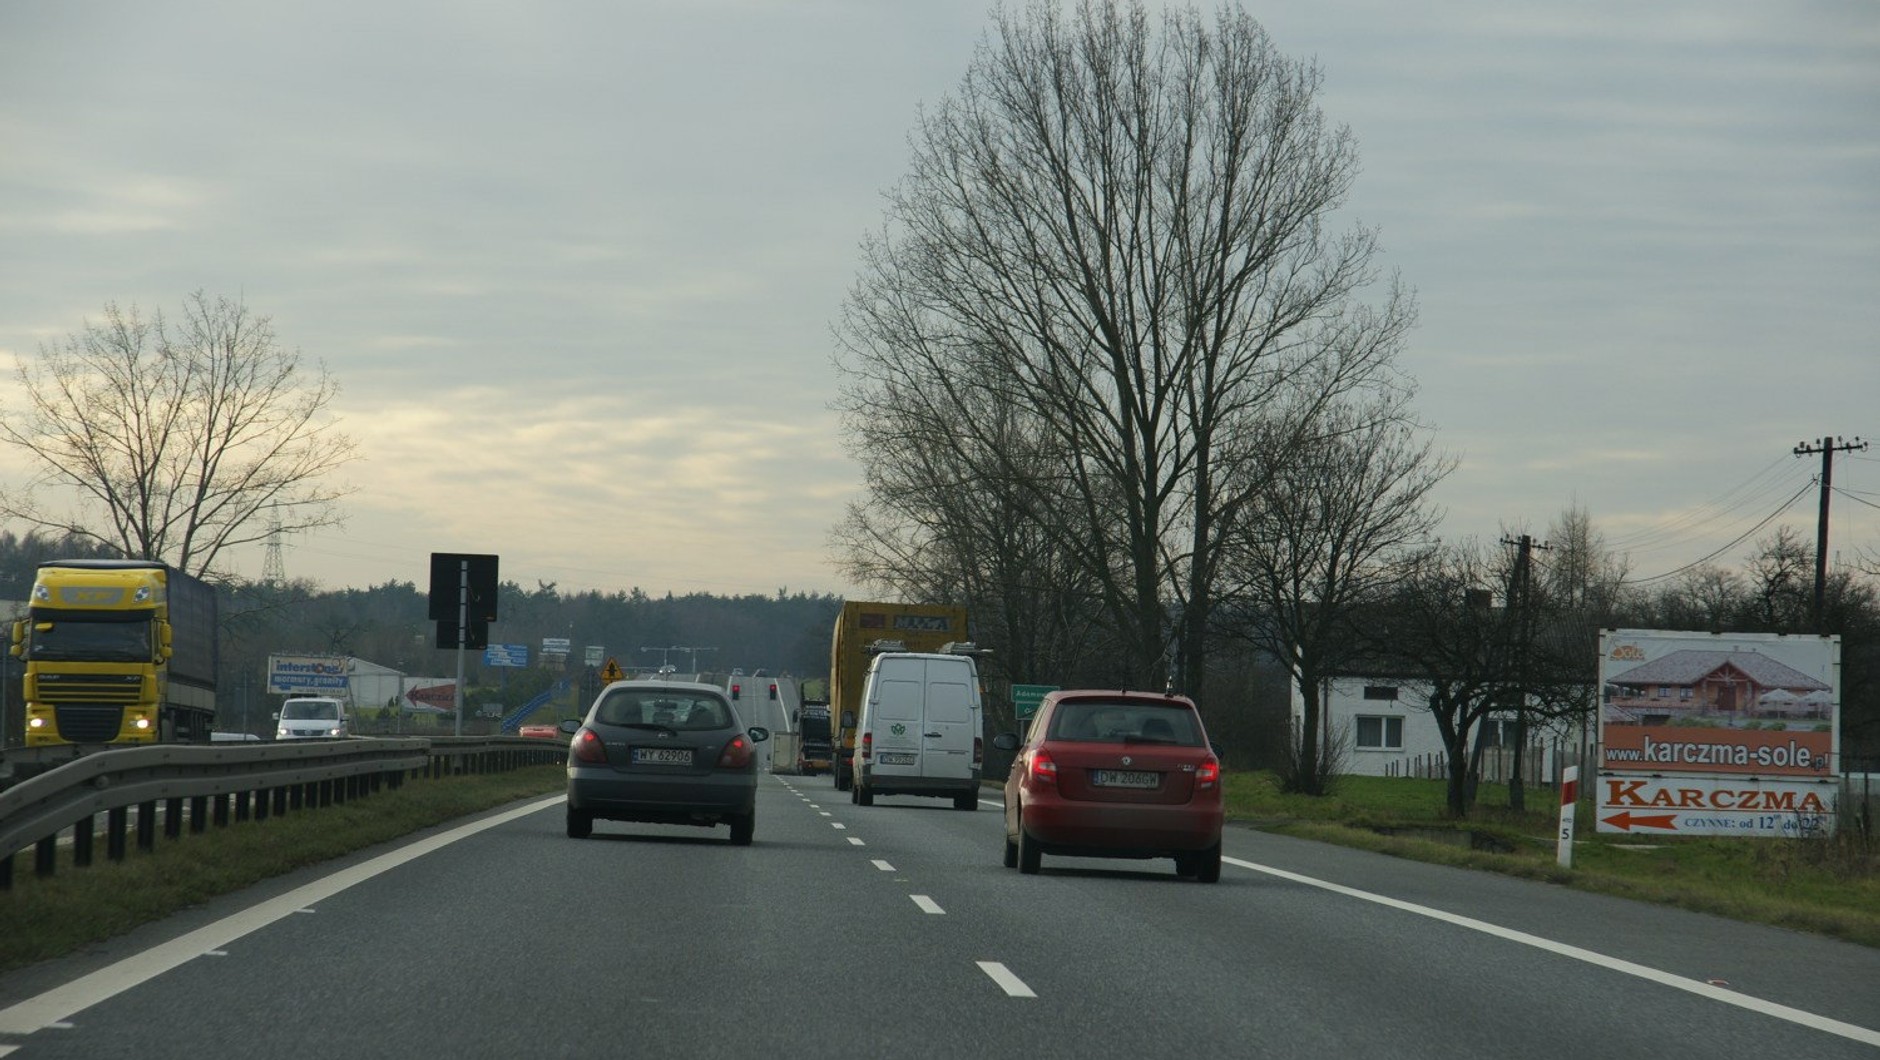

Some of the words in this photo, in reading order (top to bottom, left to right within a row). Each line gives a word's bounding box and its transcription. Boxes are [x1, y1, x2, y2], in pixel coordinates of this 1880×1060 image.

[640, 749, 655, 761] WY
[658, 750, 691, 763] 62906
[1606, 736, 1829, 769] www.karczma-sole.pl
[1100, 771, 1117, 783] DW
[1121, 772, 1157, 786] 206GW
[1605, 780, 1826, 811] KARCZMA
[1739, 817, 1753, 829] od
[1783, 819, 1798, 830] do
[1562, 828, 1570, 840] 5
